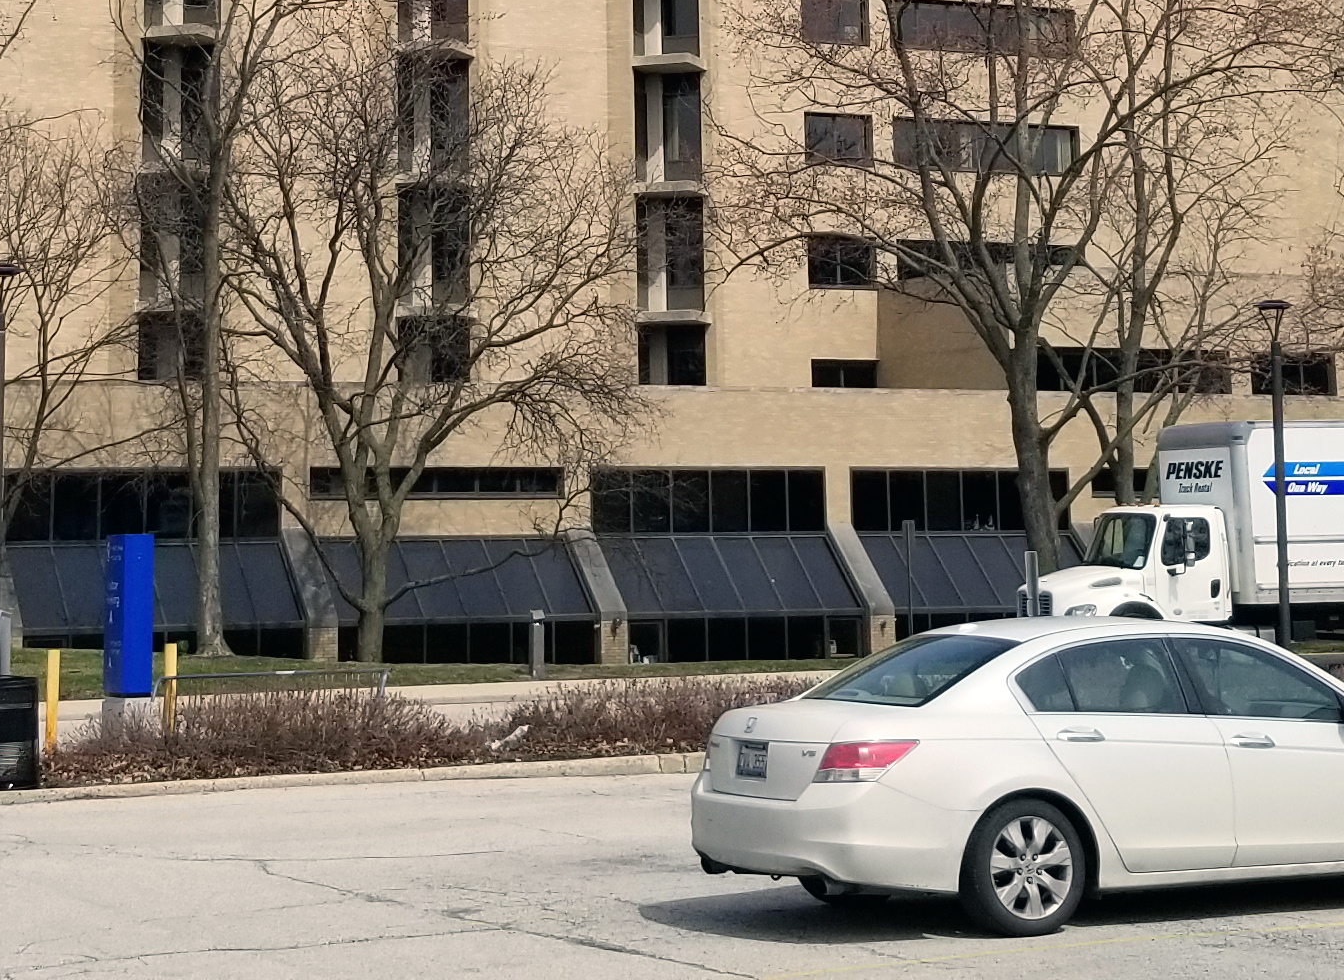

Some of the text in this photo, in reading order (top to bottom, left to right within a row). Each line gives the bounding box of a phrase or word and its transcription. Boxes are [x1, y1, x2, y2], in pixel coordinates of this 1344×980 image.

[1166, 460, 1224, 480] PENSKE
[1293, 463, 1321, 475] Local
[1178, 482, 1213, 494] Truck Rental
[1287, 481, 1329, 494] One Way
